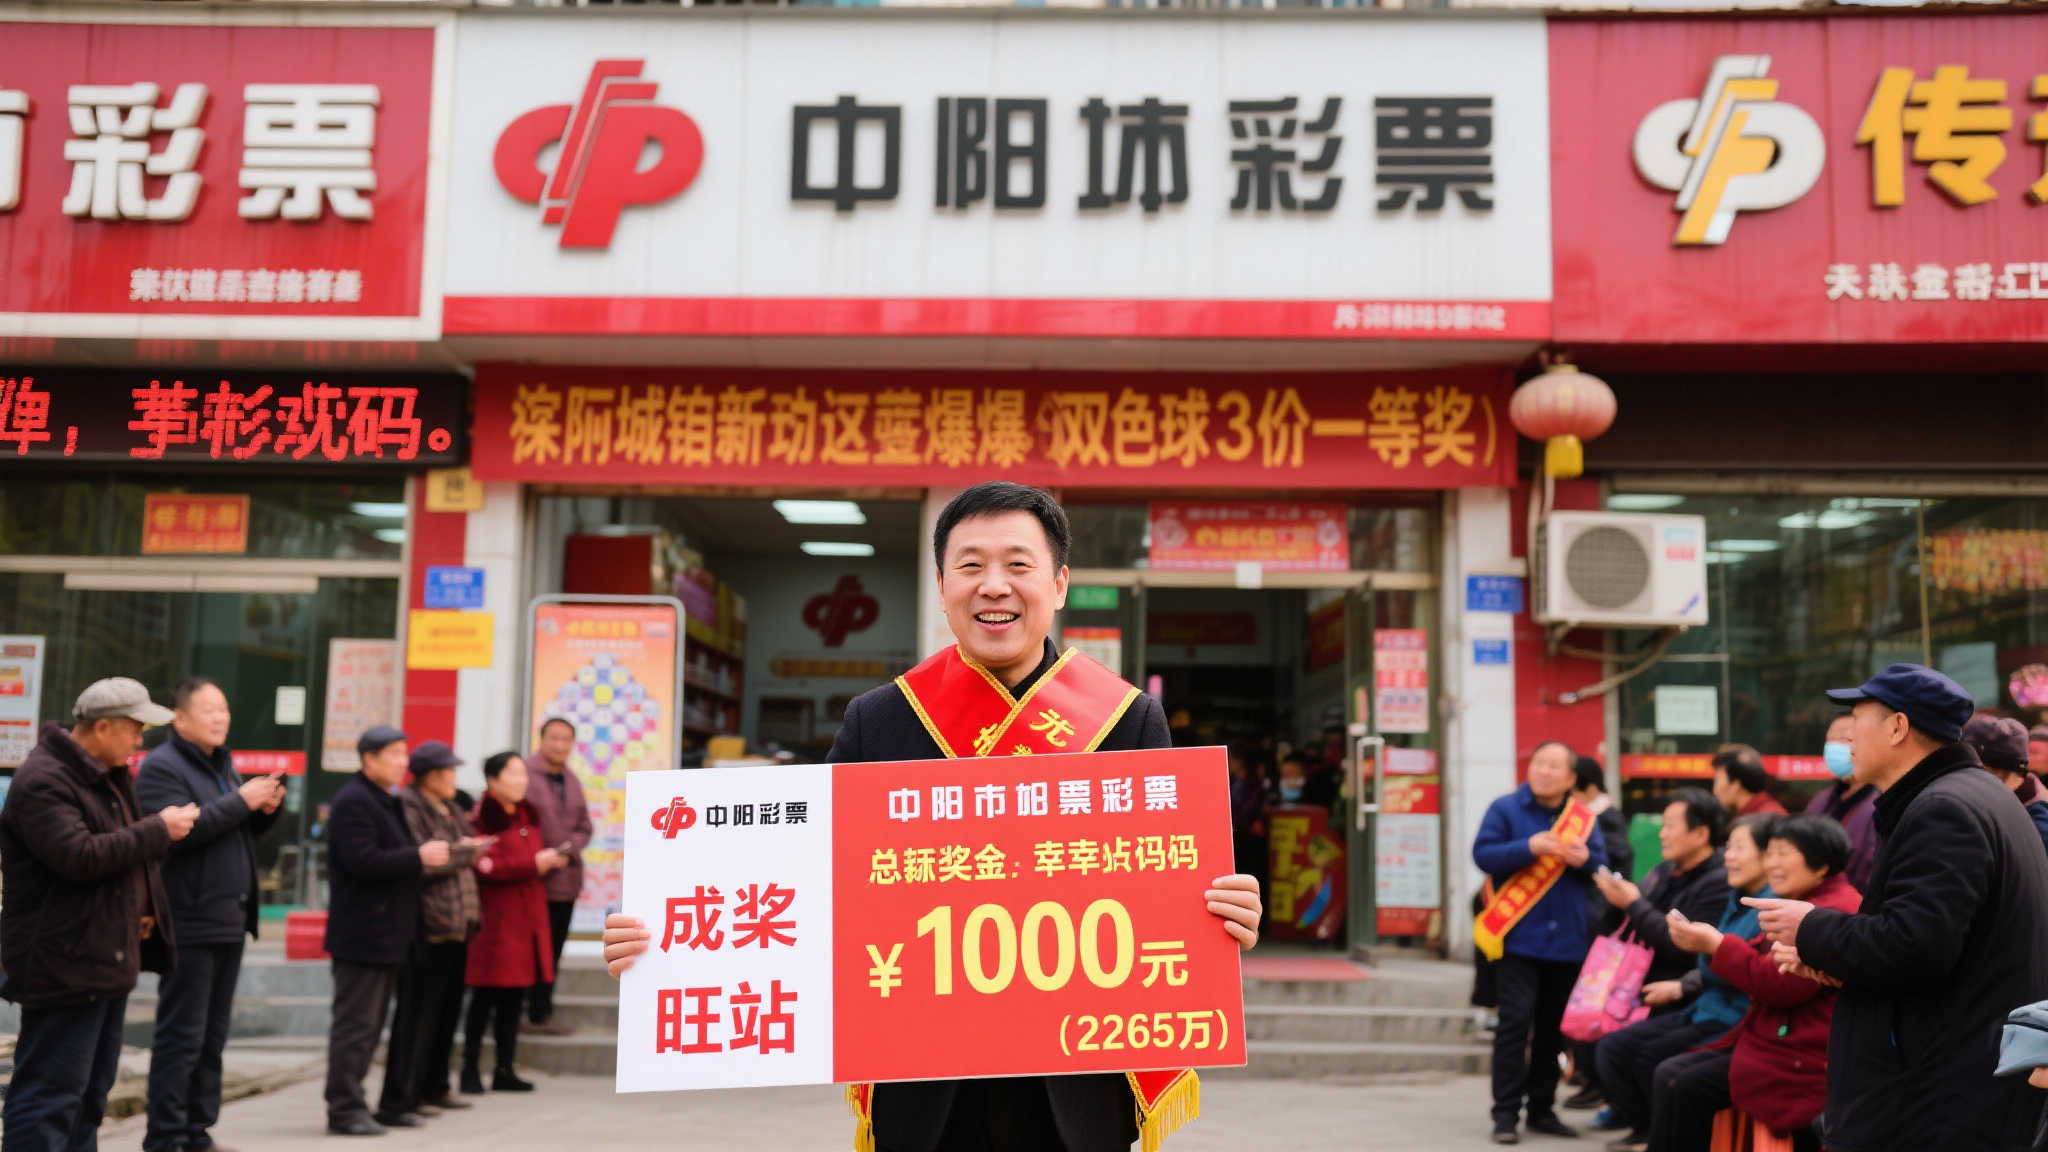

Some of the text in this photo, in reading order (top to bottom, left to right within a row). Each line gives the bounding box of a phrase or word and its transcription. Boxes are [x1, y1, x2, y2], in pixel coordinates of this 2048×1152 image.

[705, 801, 808, 828] 中阳彩票
[656, 979, 798, 1055] 旺站
